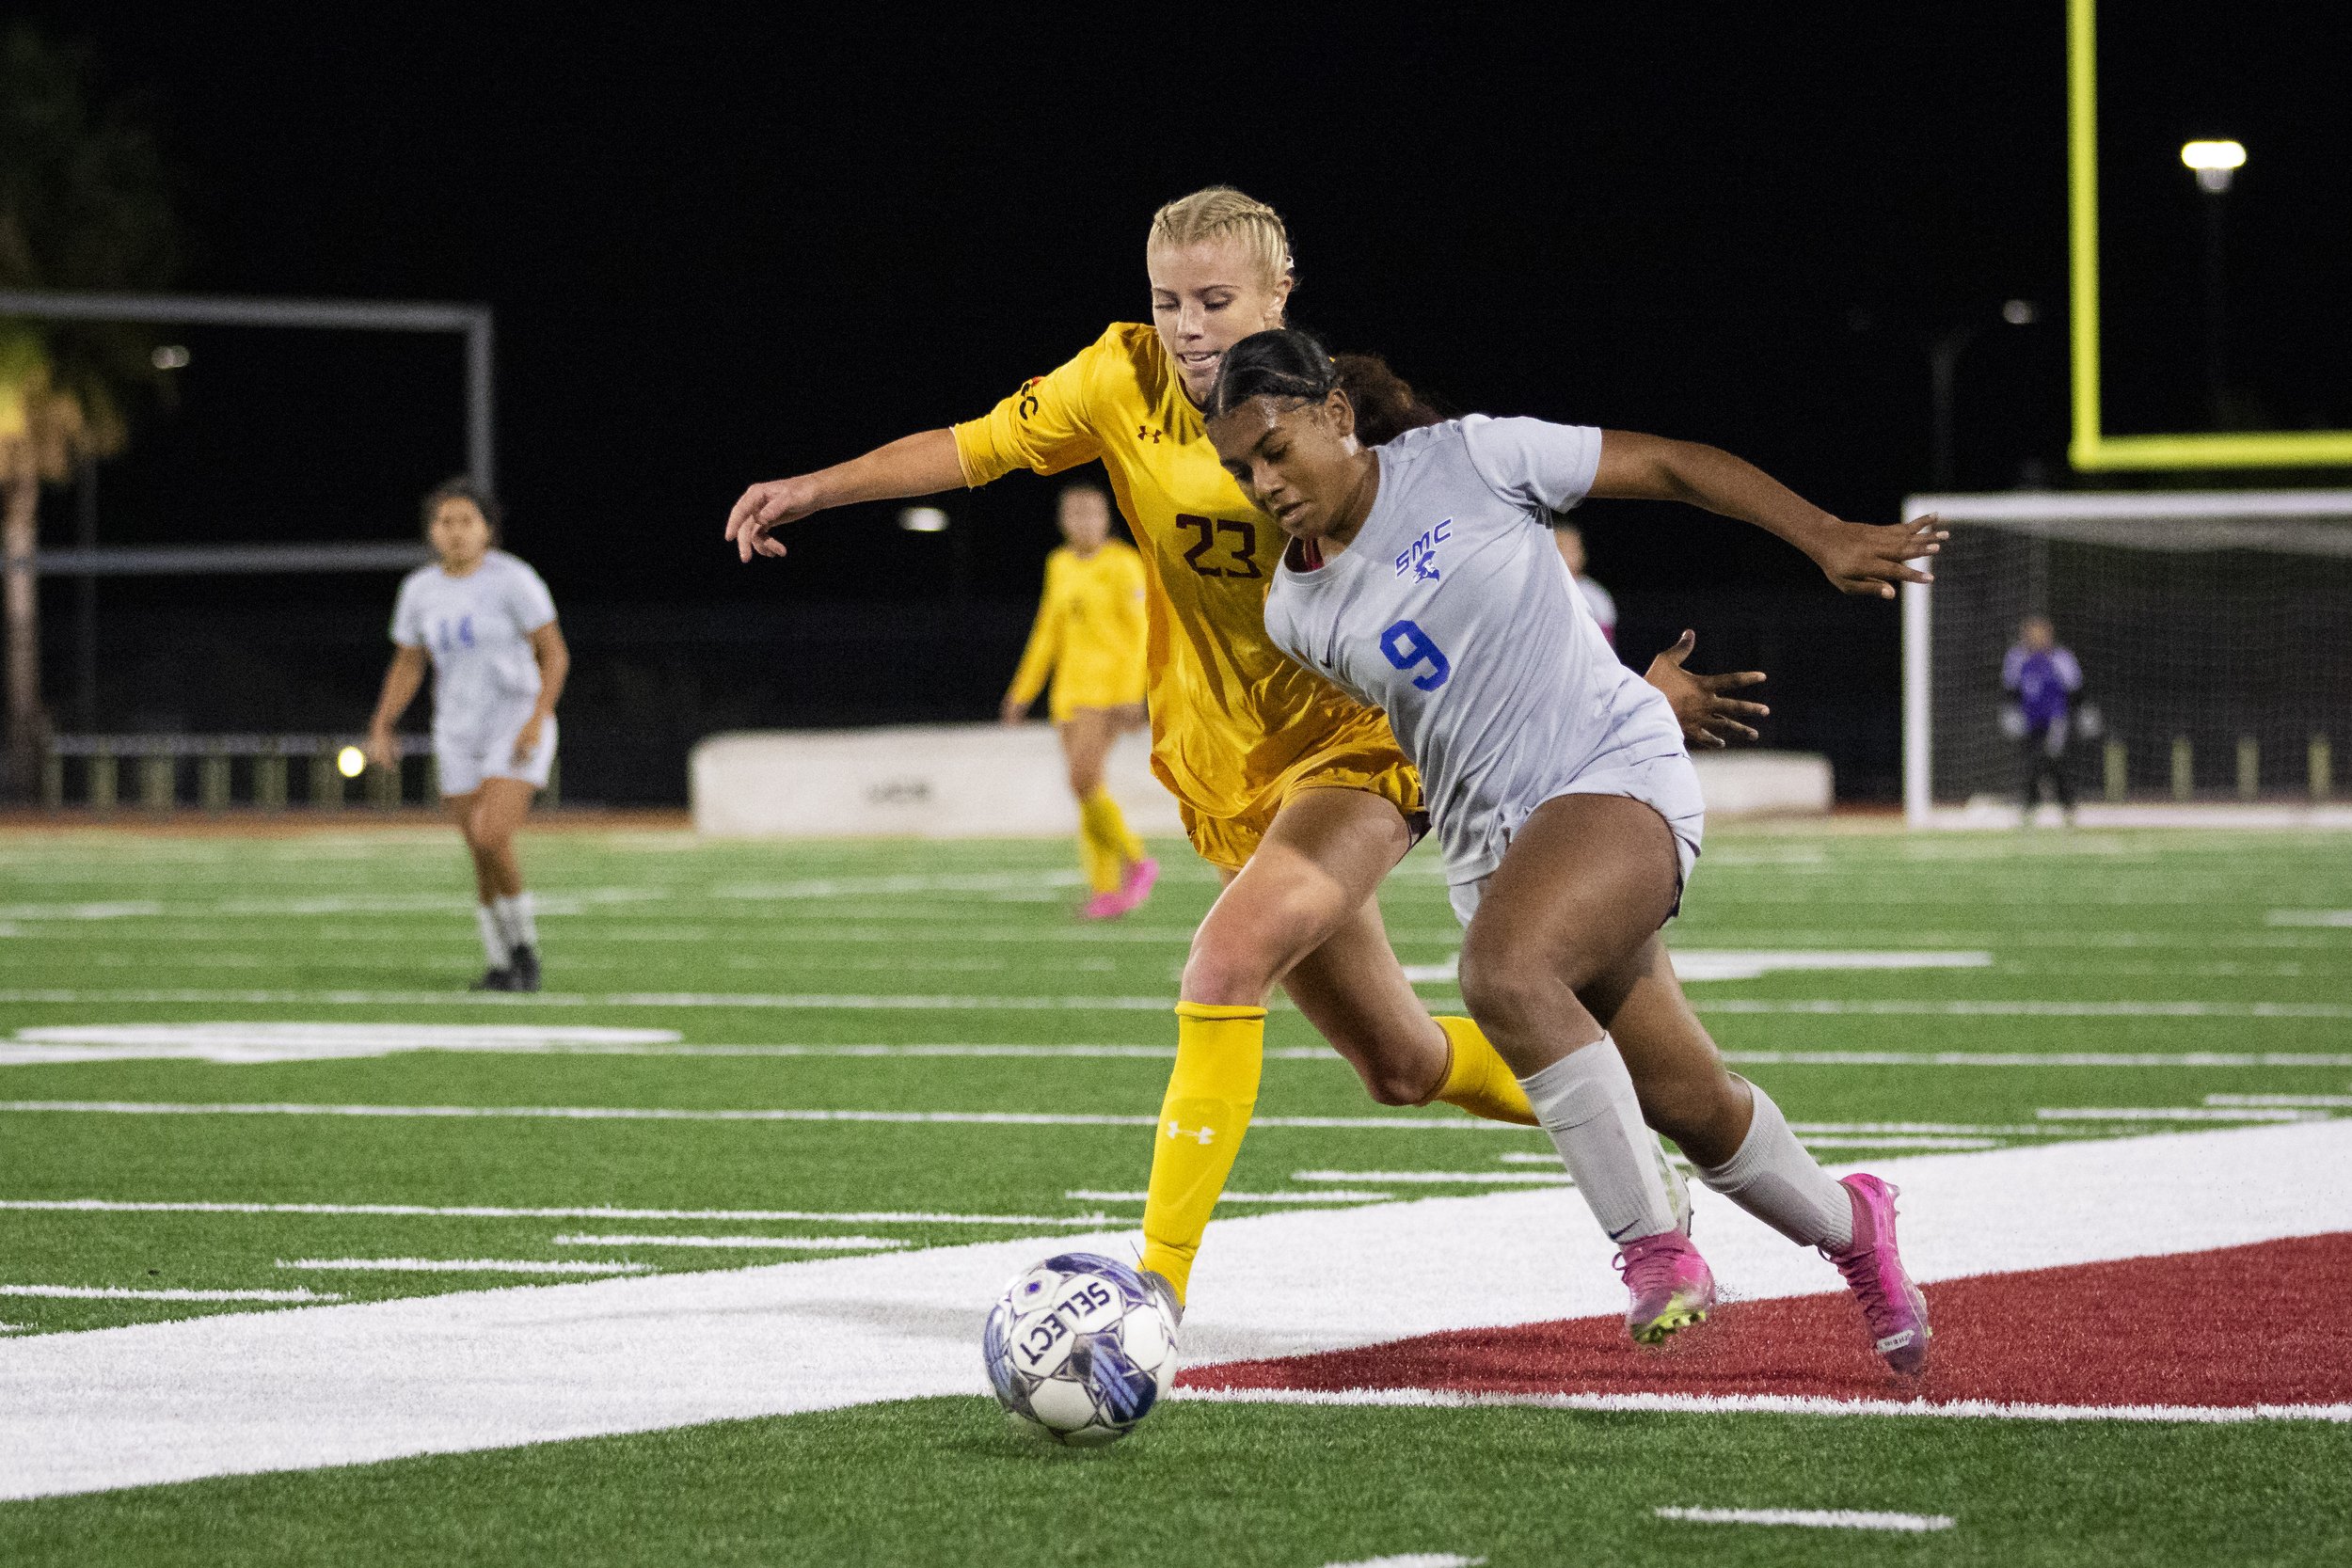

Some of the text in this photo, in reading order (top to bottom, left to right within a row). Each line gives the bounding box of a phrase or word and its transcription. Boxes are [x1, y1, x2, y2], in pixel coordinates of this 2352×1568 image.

[1176, 513, 1263, 578] 23
[1395, 517, 1453, 578] SMC
[1380, 620, 1451, 692] 9
[1020, 1282, 1111, 1366] SELECT
